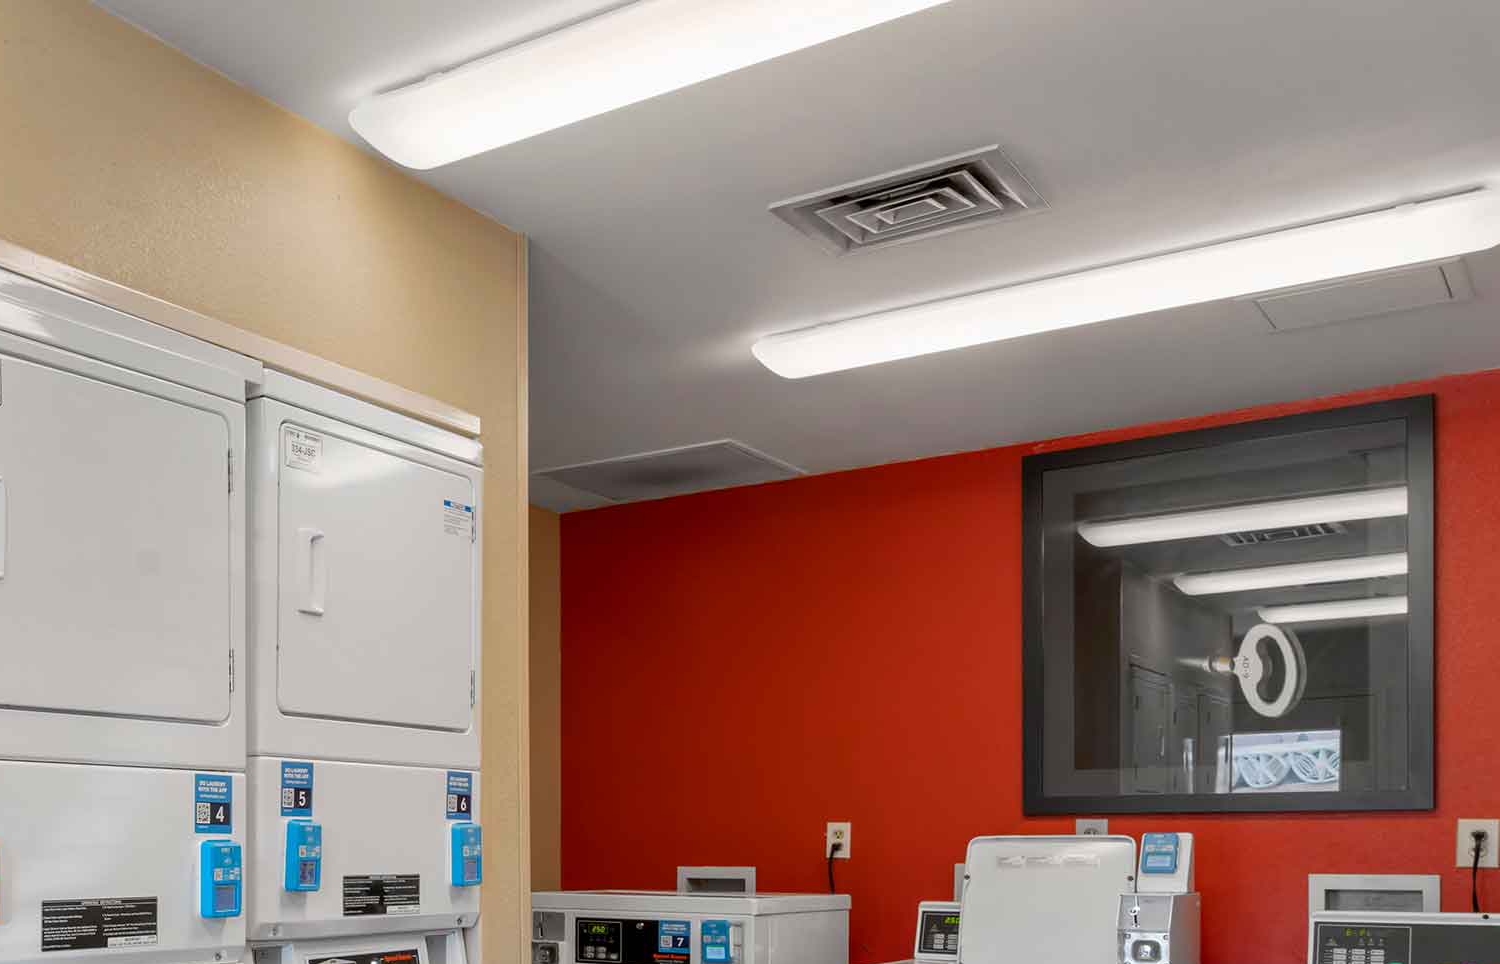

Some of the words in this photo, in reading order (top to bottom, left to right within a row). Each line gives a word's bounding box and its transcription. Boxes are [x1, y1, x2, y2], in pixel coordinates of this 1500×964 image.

[298, 791, 306, 807] 5
[460, 797, 467, 812] 6
[215, 805, 225, 823] 4
[676, 937, 685, 947] 7
